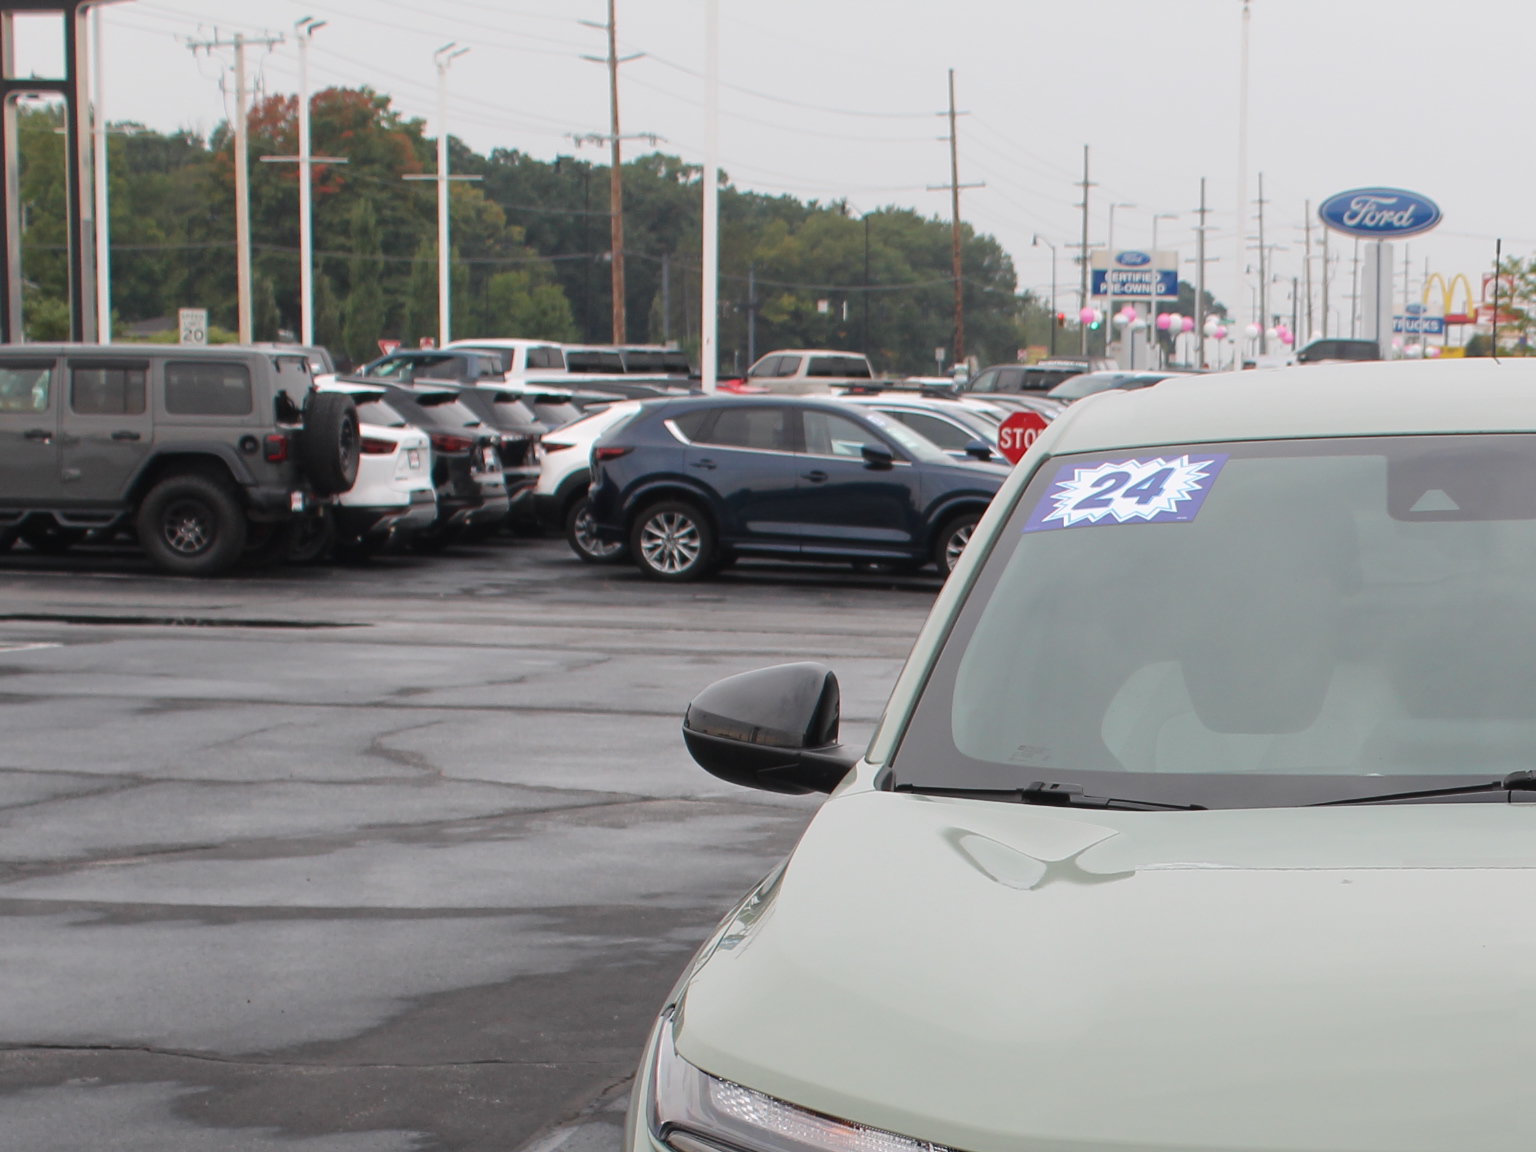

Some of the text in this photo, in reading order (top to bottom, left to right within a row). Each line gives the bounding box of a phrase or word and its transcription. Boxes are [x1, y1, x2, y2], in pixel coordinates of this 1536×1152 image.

[1342, 195, 1417, 227] Ford
[183, 329, 204, 343] 20
[1000, 427, 1043, 449] STO
[1071, 467, 1176, 510] 24
